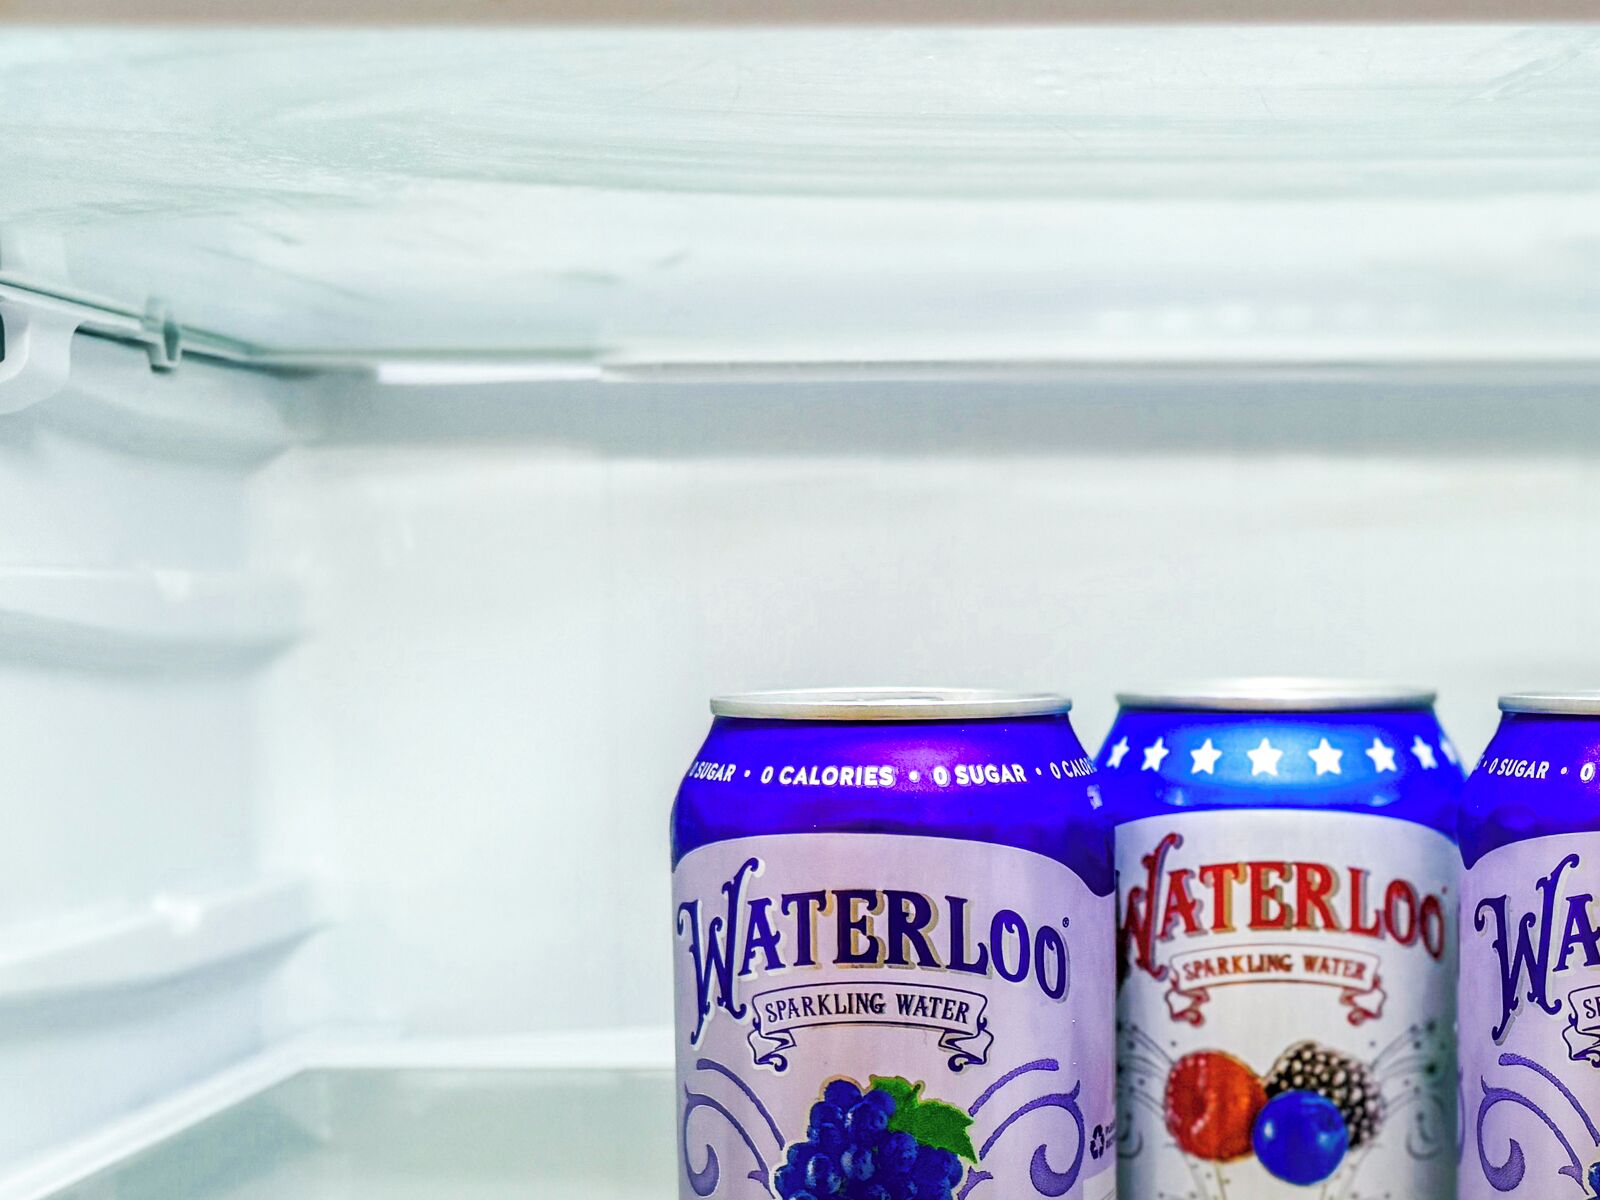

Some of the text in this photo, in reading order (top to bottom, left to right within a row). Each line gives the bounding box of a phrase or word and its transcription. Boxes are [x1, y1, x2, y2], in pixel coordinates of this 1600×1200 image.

[694, 761, 737, 782] SUGAR
[760, 766, 774, 784] 0
[778, 766, 895, 786] CALORIES
[933, 765, 948, 786] 0
[954, 764, 1027, 785] SUGAR
[1050, 762, 1061, 779] 0
[1488, 758, 1498, 775] 0
[1496, 758, 1549, 779] SUGAR
[1580, 762, 1595, 783] 0
[678, 857, 1070, 1050] WATERLOO
[1182, 955, 1366, 982] SPARKLING WATER
[765, 992, 971, 1024] SPARKLING WATER
